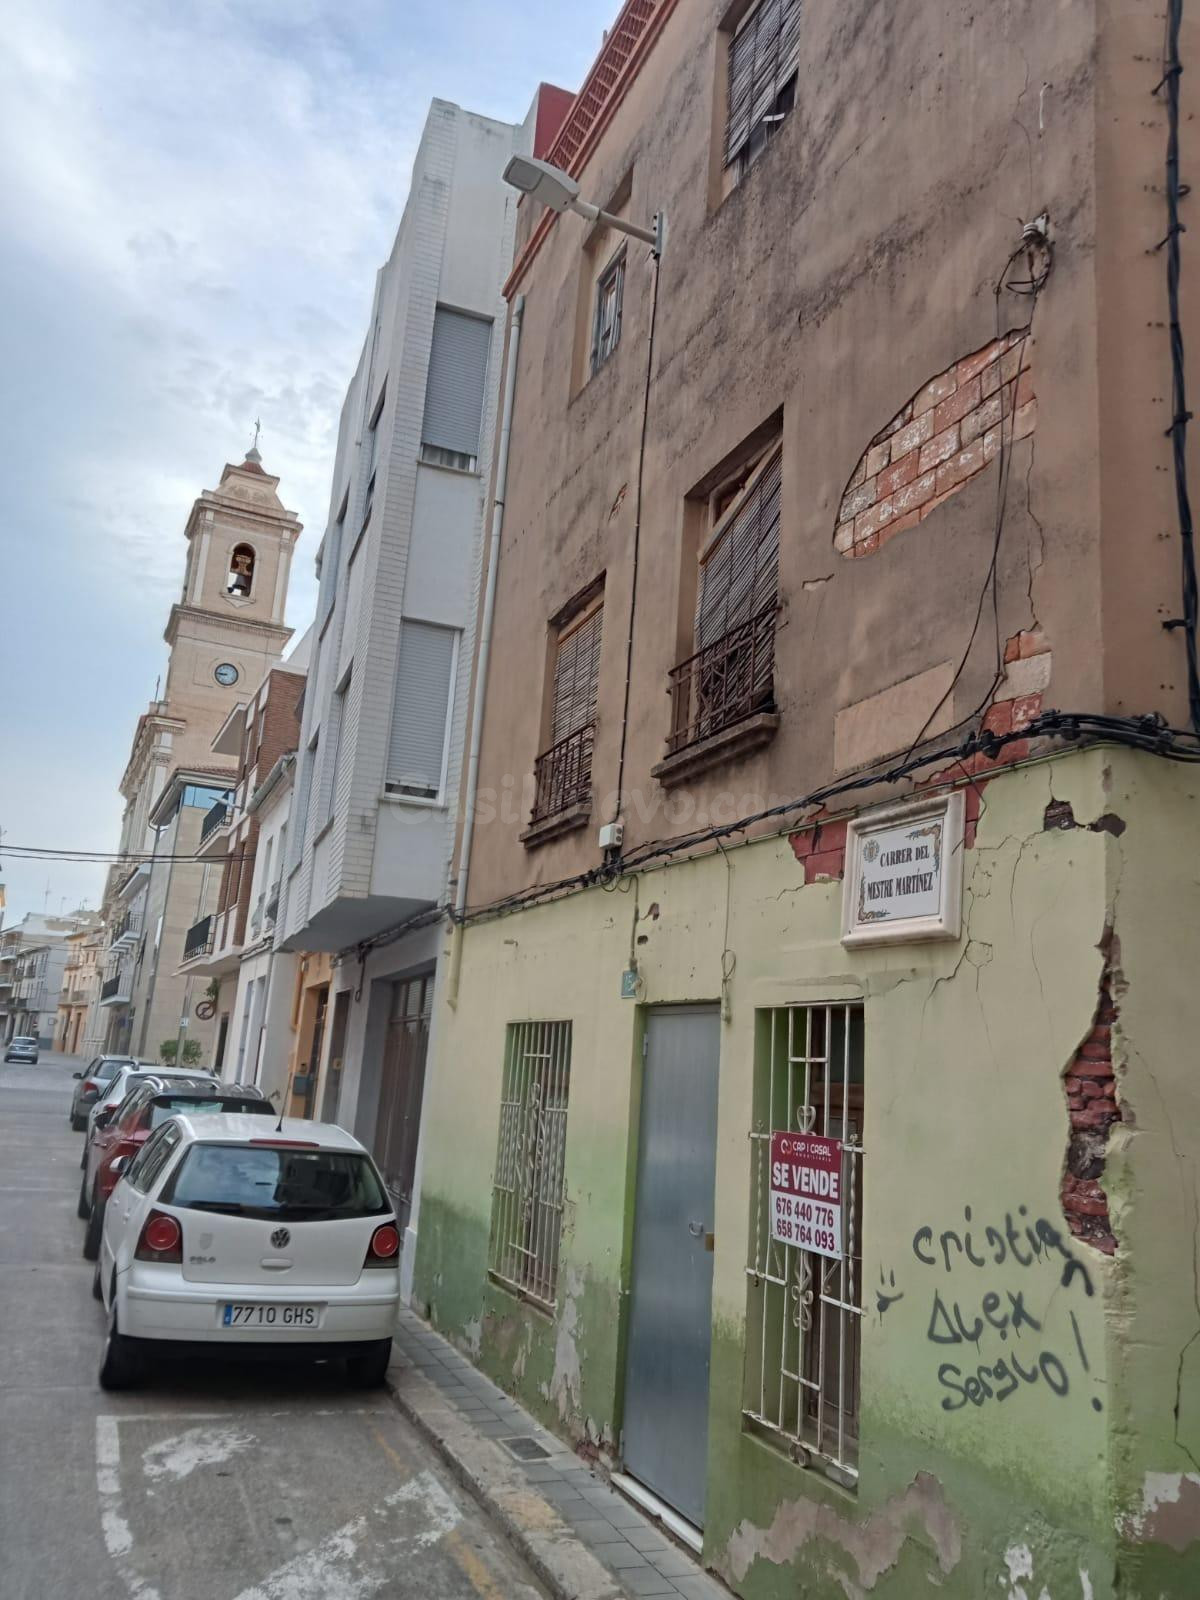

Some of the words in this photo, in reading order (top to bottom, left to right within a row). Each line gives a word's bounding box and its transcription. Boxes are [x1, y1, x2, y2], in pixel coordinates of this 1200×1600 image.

[880, 847, 912, 867] CARRER
[915, 845, 930, 861] DEL
[867, 878, 893, 901] MESTRE
[895, 868, 934, 896] MARTÍNEZ
[792, 1141, 806, 1151] CAP
[810, 1143, 832, 1157] CASAL
[772, 1161, 790, 1188] SE
[792, 1165, 839, 1199] VENDE
[776, 1197, 792, 1217] 676
[794, 1202, 813, 1223] 440
[815, 1206, 834, 1229] 776
[776, 1218, 793, 1239] 658
[795, 1222, 812, 1245] 764
[815, 1229, 835, 1251] 093
[232, 1305, 277, 1324] 7710
[282, 1306, 315, 1325] GHS
